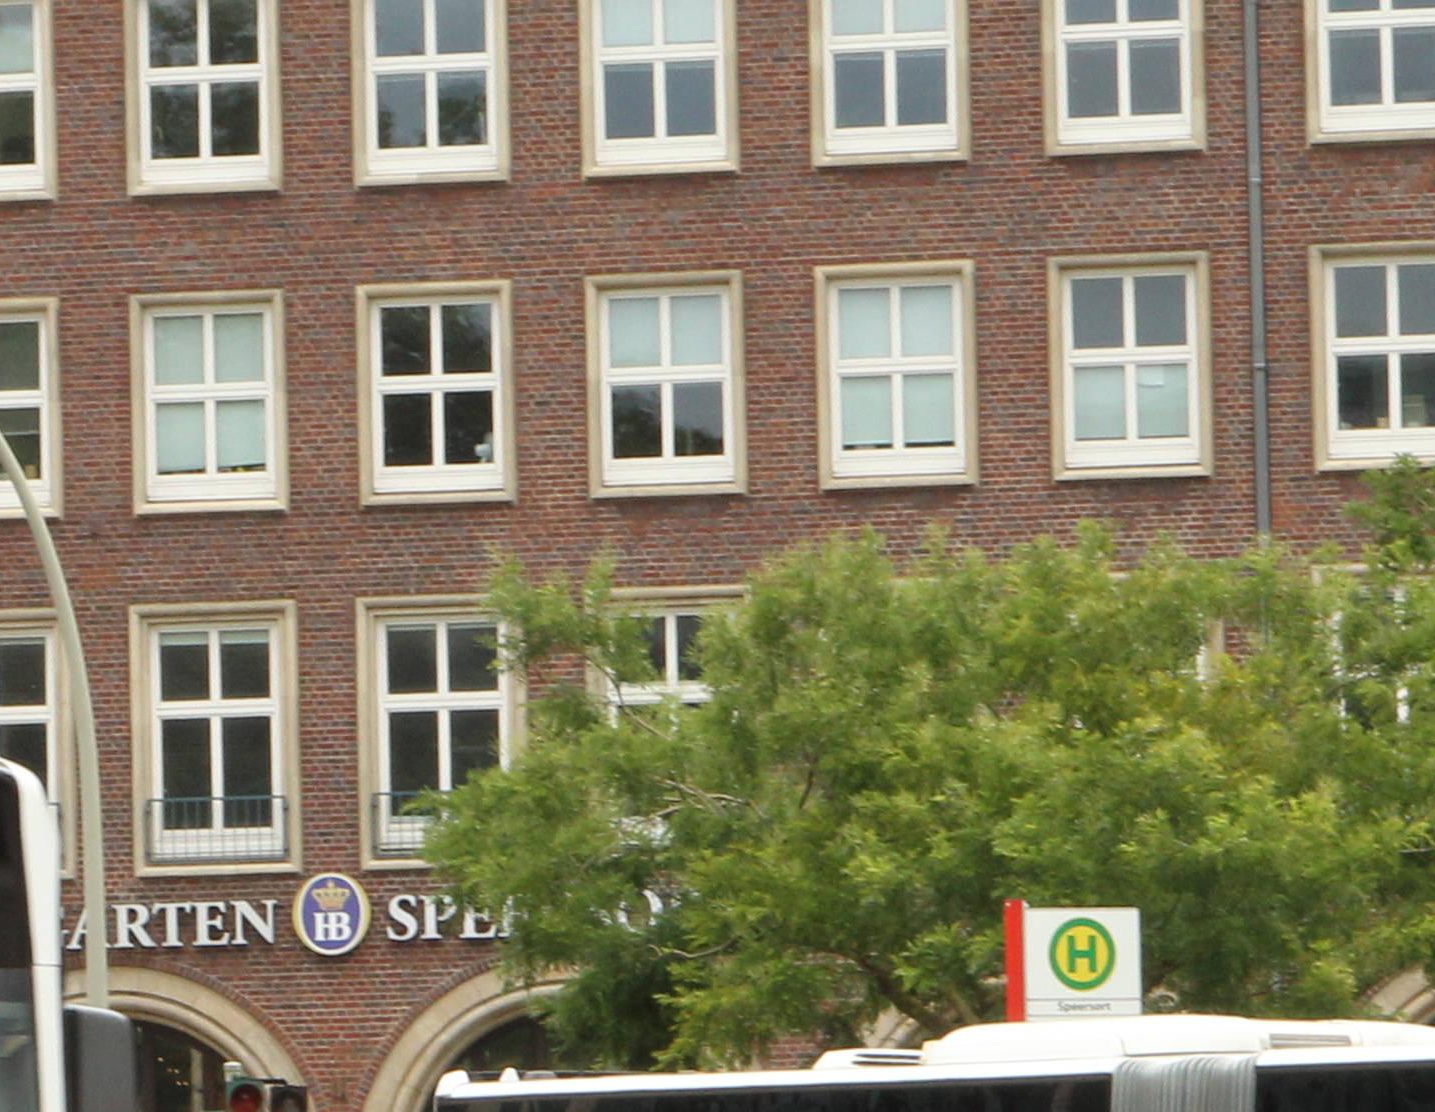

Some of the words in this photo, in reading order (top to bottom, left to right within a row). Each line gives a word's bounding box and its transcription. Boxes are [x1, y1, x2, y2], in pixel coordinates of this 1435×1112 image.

[61, 899, 278, 950] ARTEN
[313, 911, 352, 942] HB
[1067, 935, 1097, 973] H
